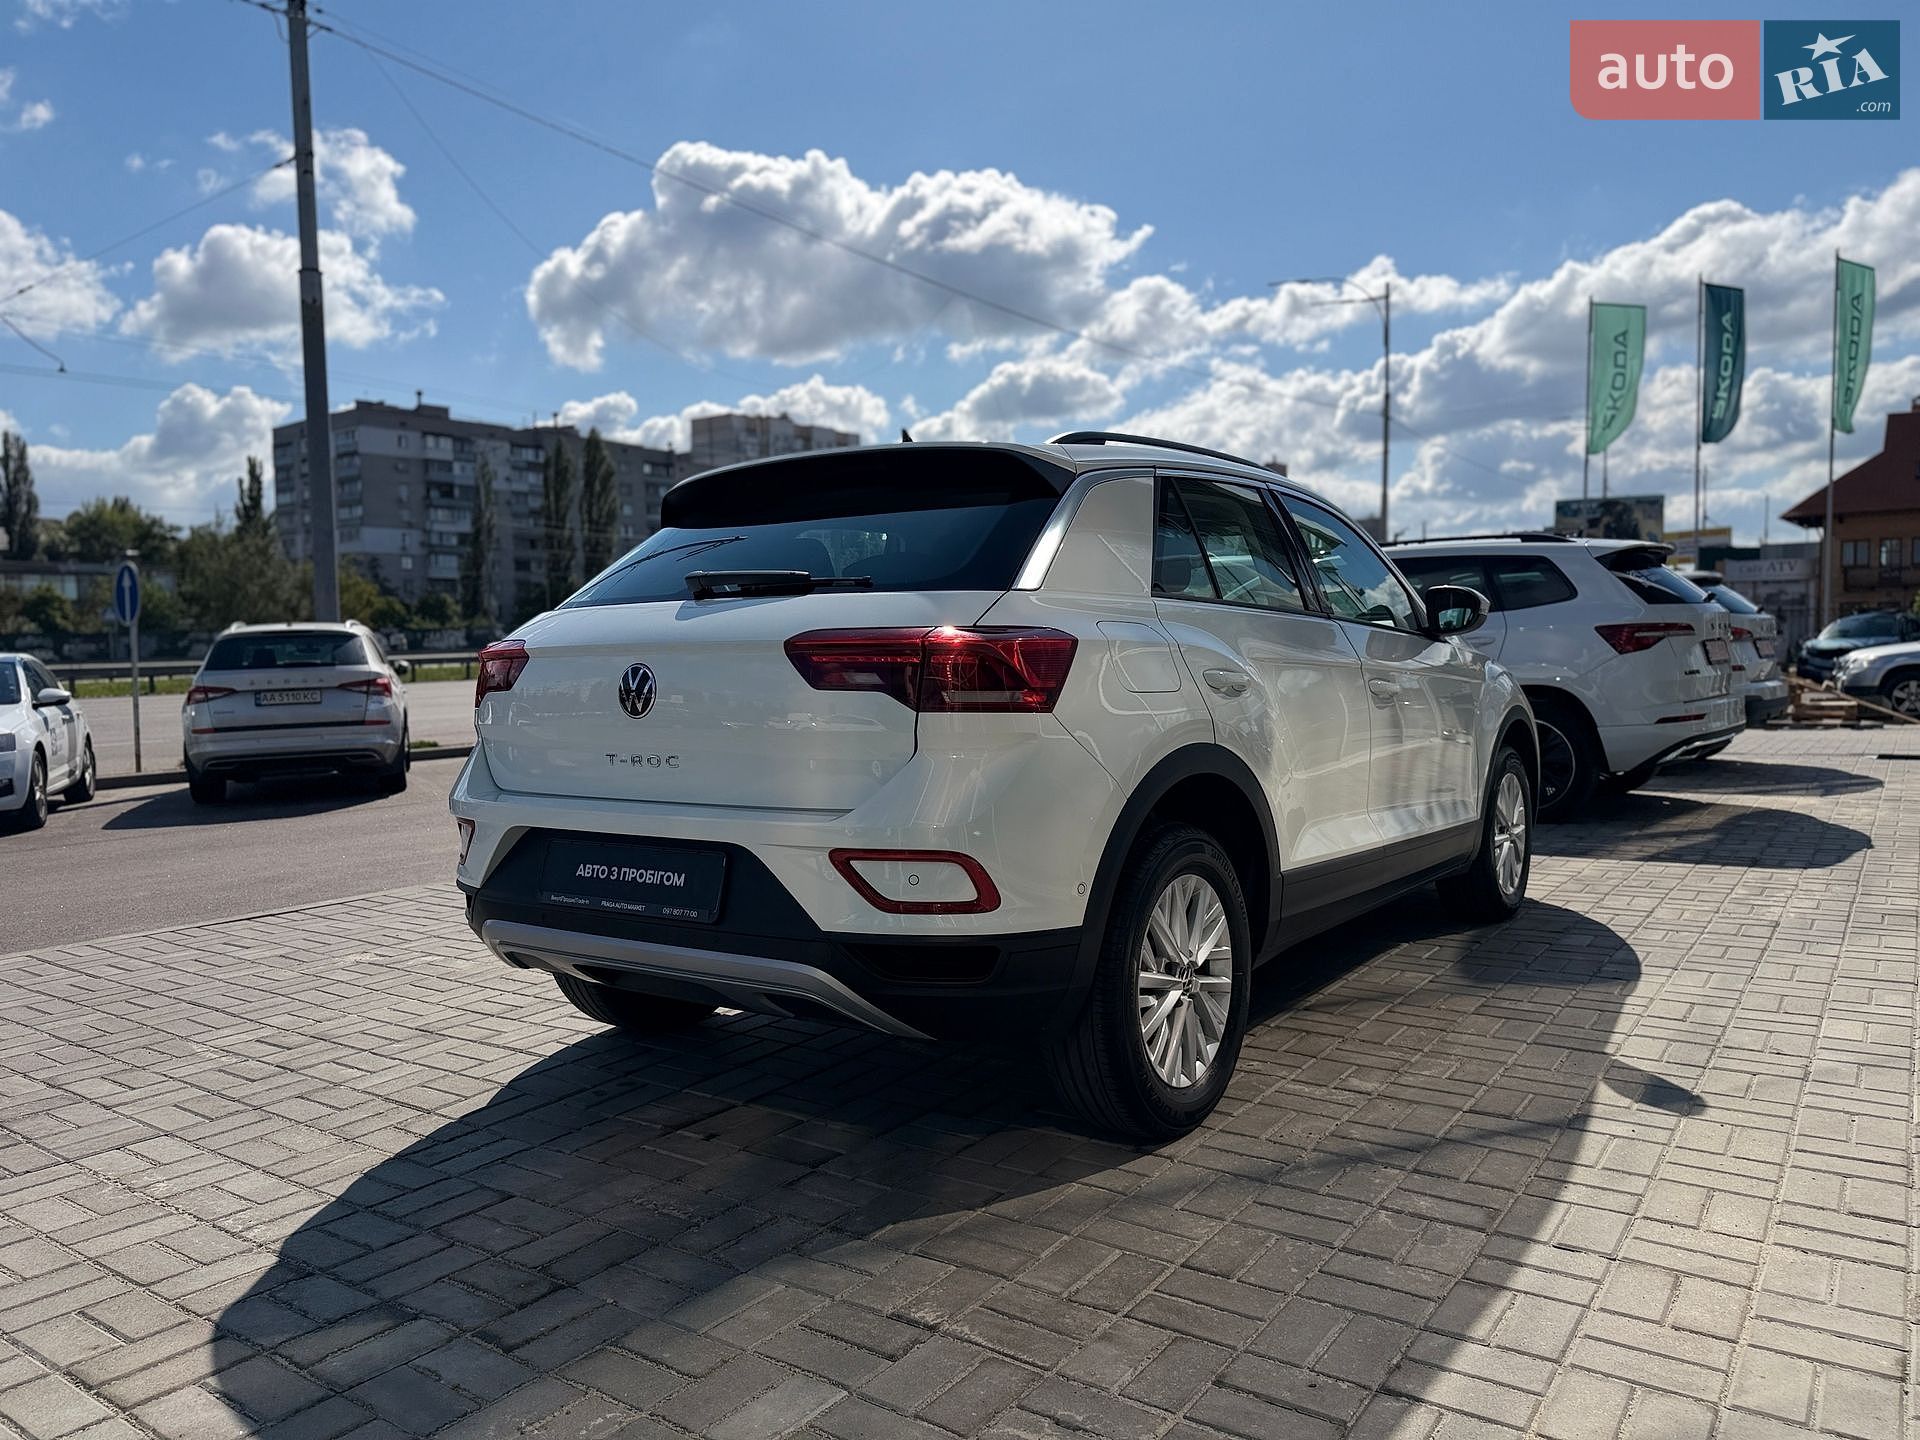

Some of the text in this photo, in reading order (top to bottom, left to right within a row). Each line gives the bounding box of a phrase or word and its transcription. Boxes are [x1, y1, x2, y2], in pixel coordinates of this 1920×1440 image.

[605, 753, 680, 768] T-ROC
[575, 863, 608, 879] АВТО
[619, 868, 685, 887] ПРОБІГОМ
